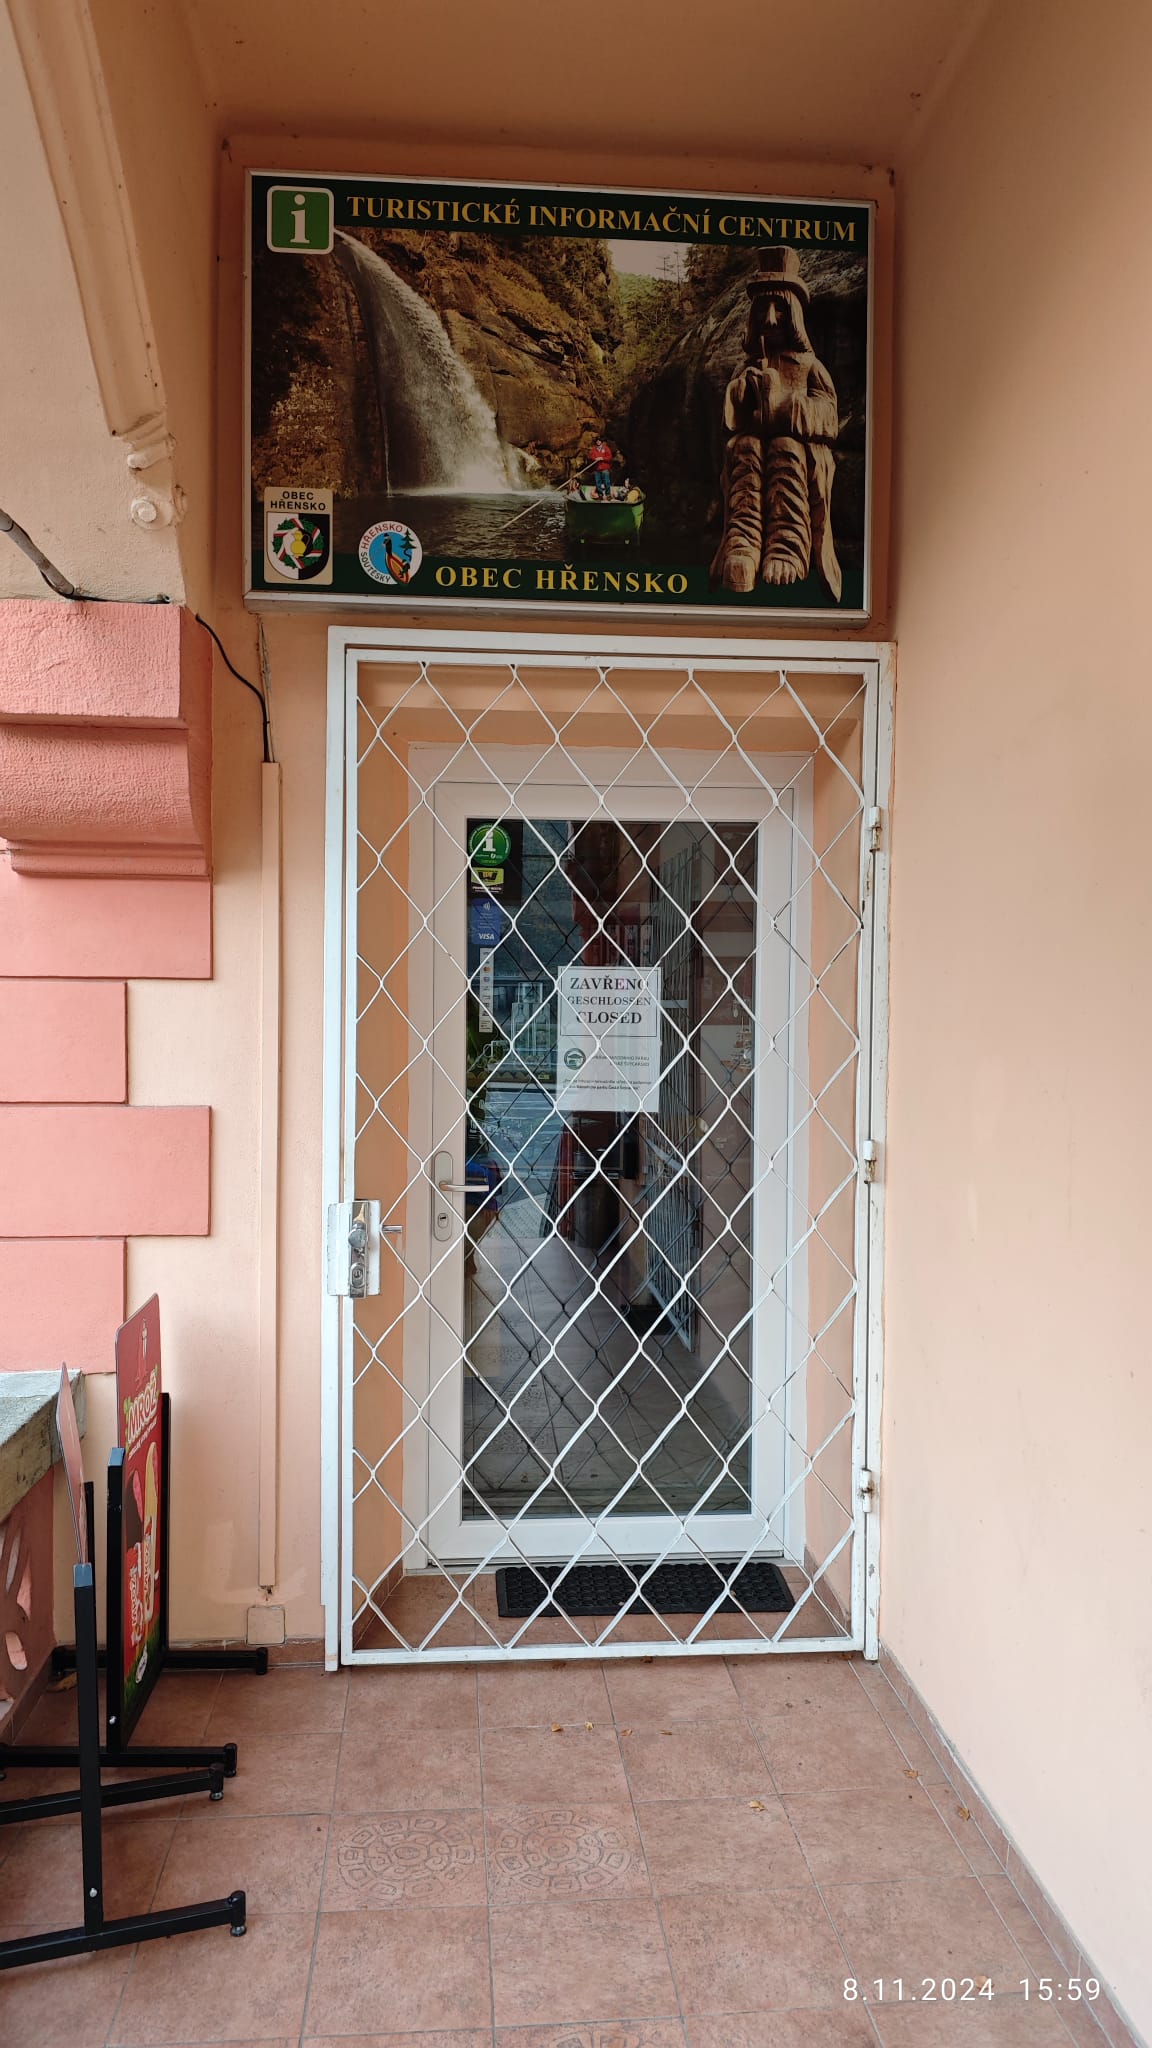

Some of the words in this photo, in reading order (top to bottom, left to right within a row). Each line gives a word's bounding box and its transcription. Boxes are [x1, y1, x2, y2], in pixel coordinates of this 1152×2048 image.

[346, 196, 521, 225] TURISTICKÉ
[529, 204, 711, 235] INFORMAČNÍ
[718, 215, 857, 242] CENTRUM
[282, 490, 314, 501] OBEC
[270, 498, 327, 511] HŘENSKO
[435, 565, 522, 589] OBEC
[535, 563, 688, 594] HŘENSKO
[478, 932, 495, 940] VISA
[570, 975, 650, 990] ZAVŘENO
[567, 996, 651, 1006] GESCHLOSSEN
[576, 1011, 642, 1024] CLOSED
